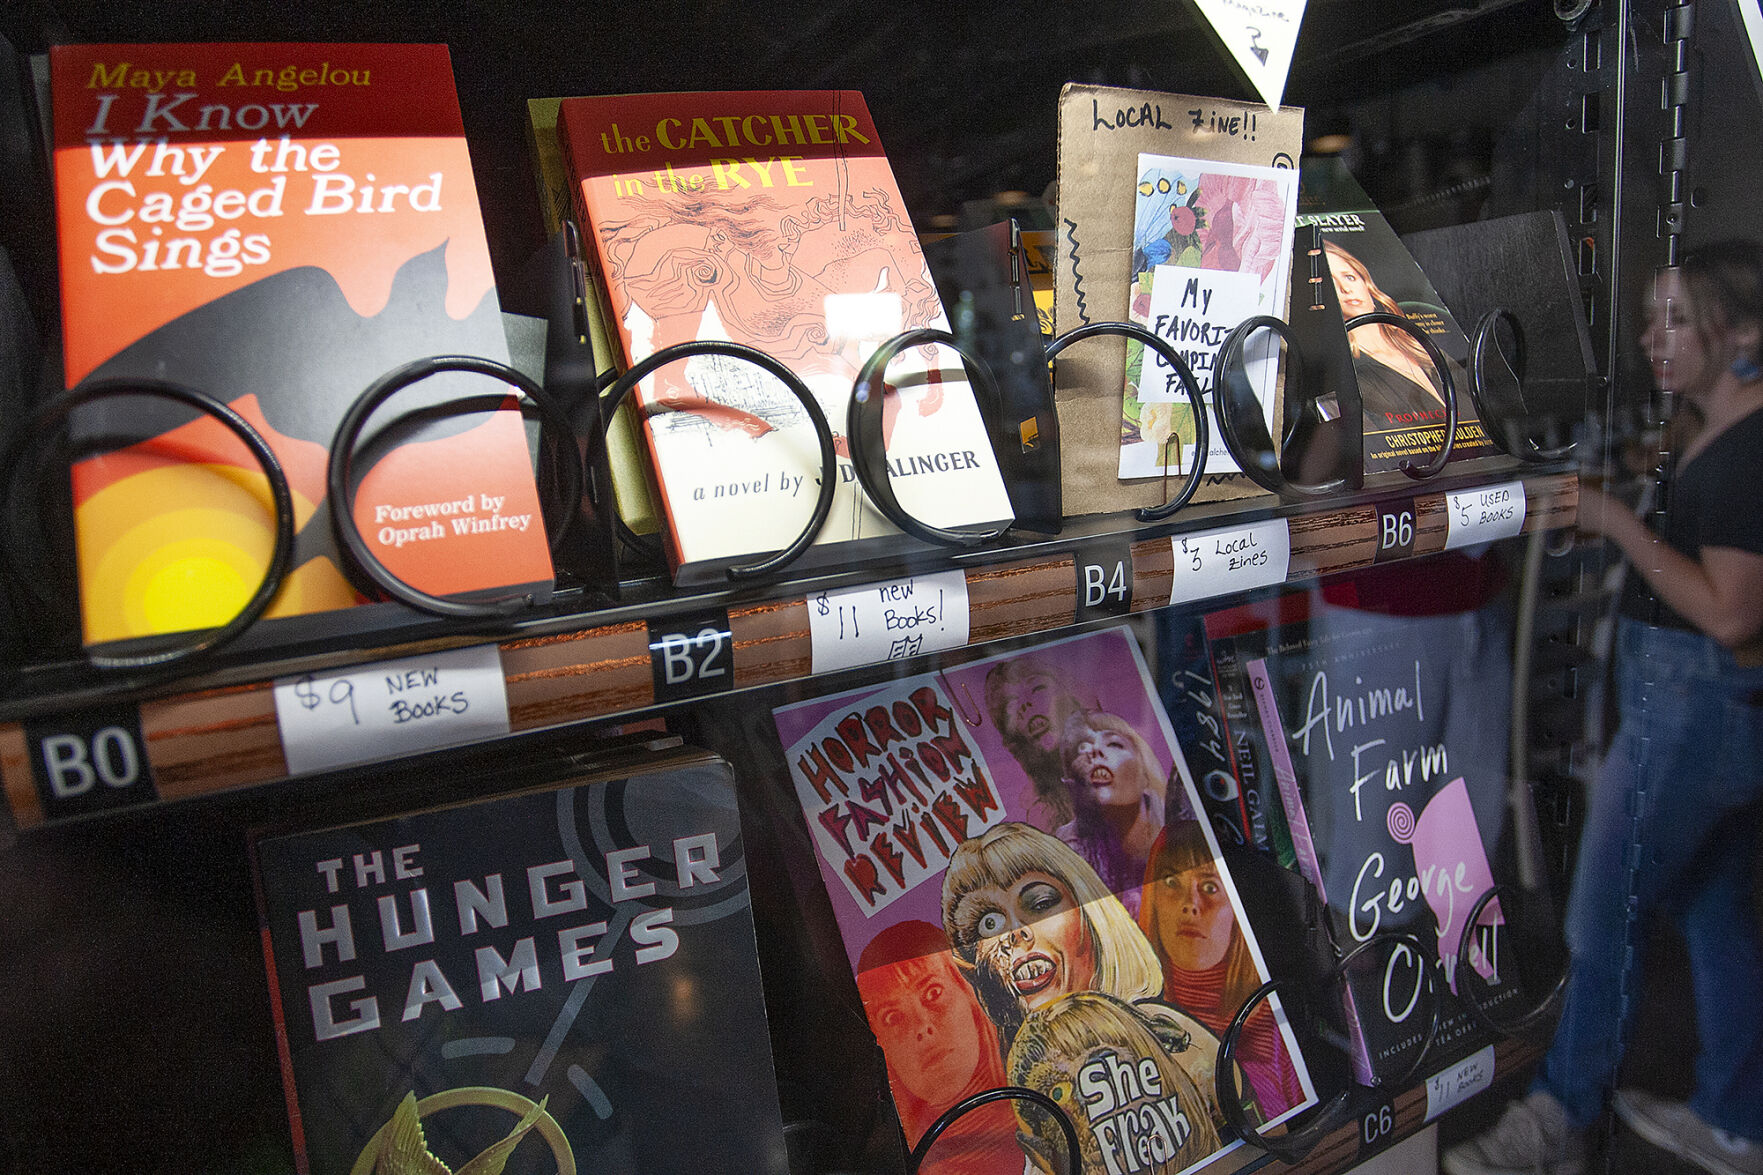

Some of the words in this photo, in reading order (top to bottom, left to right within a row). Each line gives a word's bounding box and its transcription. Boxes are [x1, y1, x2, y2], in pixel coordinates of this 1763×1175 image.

[86, 63, 197, 92] Maya
[216, 62, 371, 92] Angelou
[85, 93, 120, 134] I
[134, 92, 319, 133] Know
[601, 122, 651, 154] the
[655, 113, 871, 150] CATCHER
[1093, 98, 1172, 131] LOCAL
[86, 135, 225, 185] Why
[250, 134, 340, 174] the
[612, 174, 644, 198] in
[654, 161, 705, 194] the
[709, 155, 814, 191] RYE
[86, 178, 286, 231] Caged
[305, 173, 443, 216] Bird
[1307, 213, 1366, 227] SLAYER
[90, 227, 271, 278] Sings
[1155, 315, 1235, 347] FAVORI
[1166, 373, 1213, 395] FAL
[1455, 425, 1486, 440] OLDEN
[693, 485, 705, 501] a
[714, 472, 769, 499] novel
[780, 470, 803, 498] by
[886, 450, 981, 479] ALINGER
[375, 495, 475, 523] Foreword
[481, 493, 505, 513] by
[378, 521, 445, 548] Oprah
[451, 514, 531, 536] Winfrey
[1382, 511, 1414, 550] B6
[880, 578, 914, 604] new
[1084, 560, 1128, 608] B4
[386, 667, 440, 694] NEW
[661, 626, 726, 685] B2
[1185, 669, 1226, 762] 1984
[1291, 659, 1424, 762] Animal
[798, 685, 955, 803] HORROR
[1233, 730, 1256, 785] NEIL
[1247, 788, 1270, 852] GAIM
[1349, 738, 1448, 822] Farm
[842, 758, 1000, 908] REVIEW
[316, 843, 425, 893] THE
[297, 832, 722, 969] HUNGER
[1350, 852, 1474, 942] George
[308, 907, 680, 1041] GAMES
[1077, 1054, 1162, 1122] She
[1090, 1093, 1192, 1175] Freak
[1364, 1104, 1392, 1144] C6
